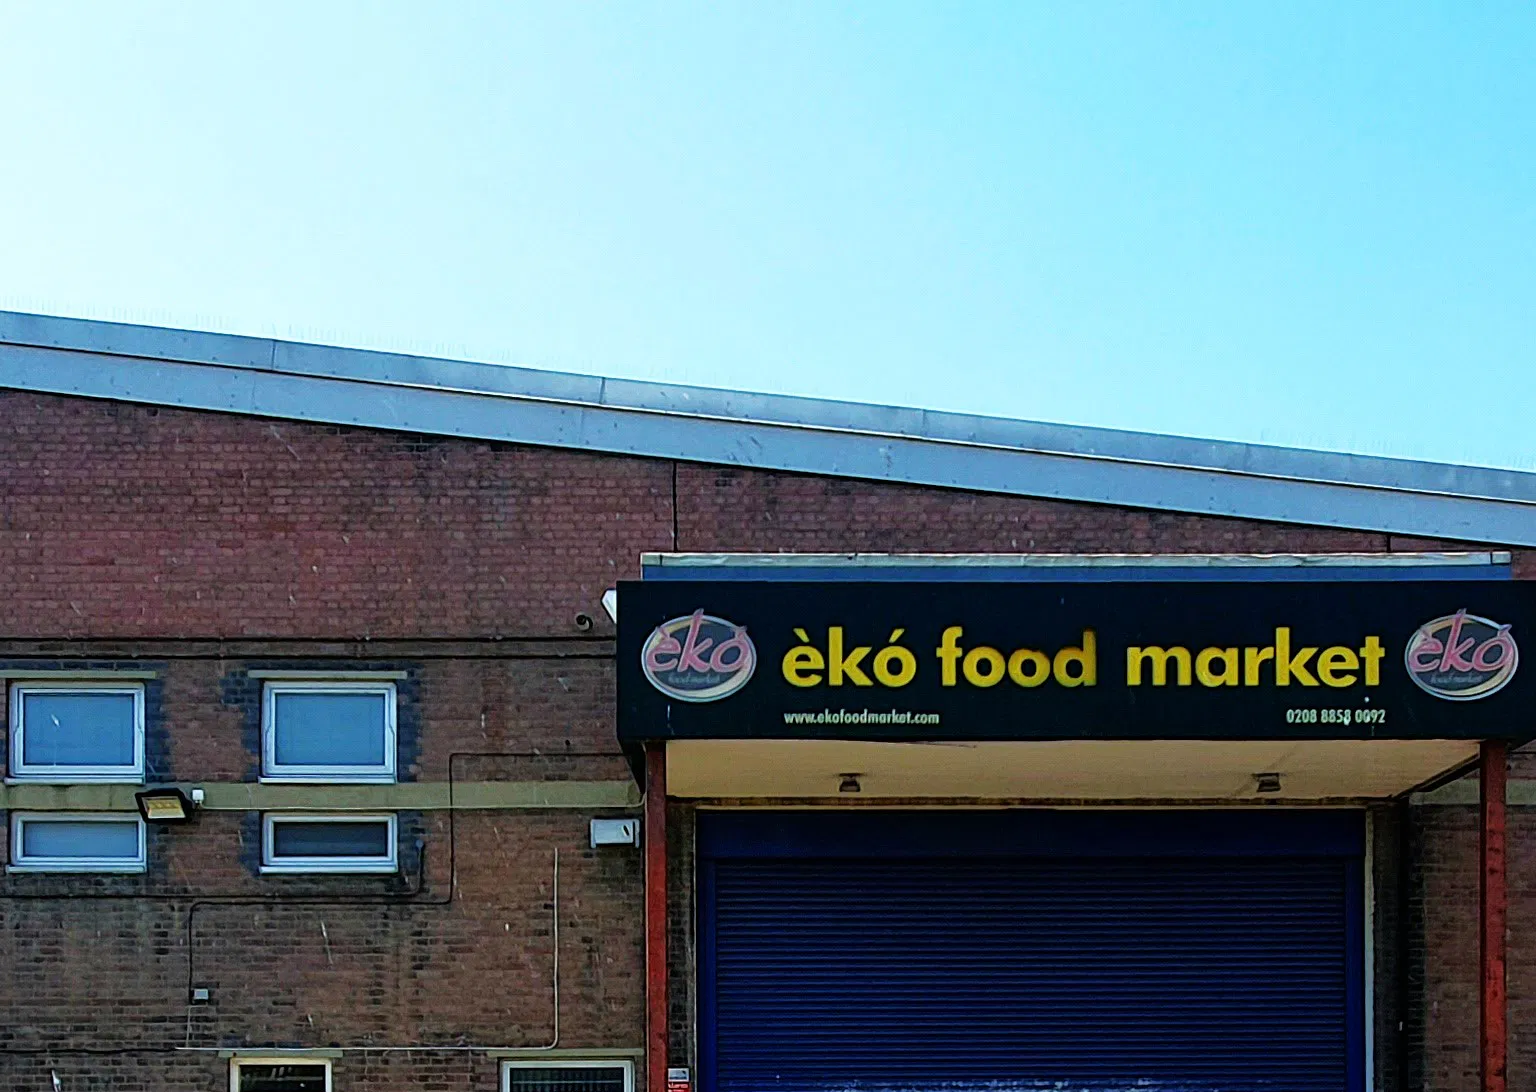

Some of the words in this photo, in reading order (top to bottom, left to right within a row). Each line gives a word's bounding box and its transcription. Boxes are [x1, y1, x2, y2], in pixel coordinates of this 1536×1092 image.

[781, 626, 917, 687] èkó
[936, 626, 1097, 687] food
[1126, 627, 1385, 687] market
[783, 708, 940, 724] www.ekofoodmarket.com
[1286, 709, 1317, 723] 0208
[1355, 709, 1386, 723] 0092
